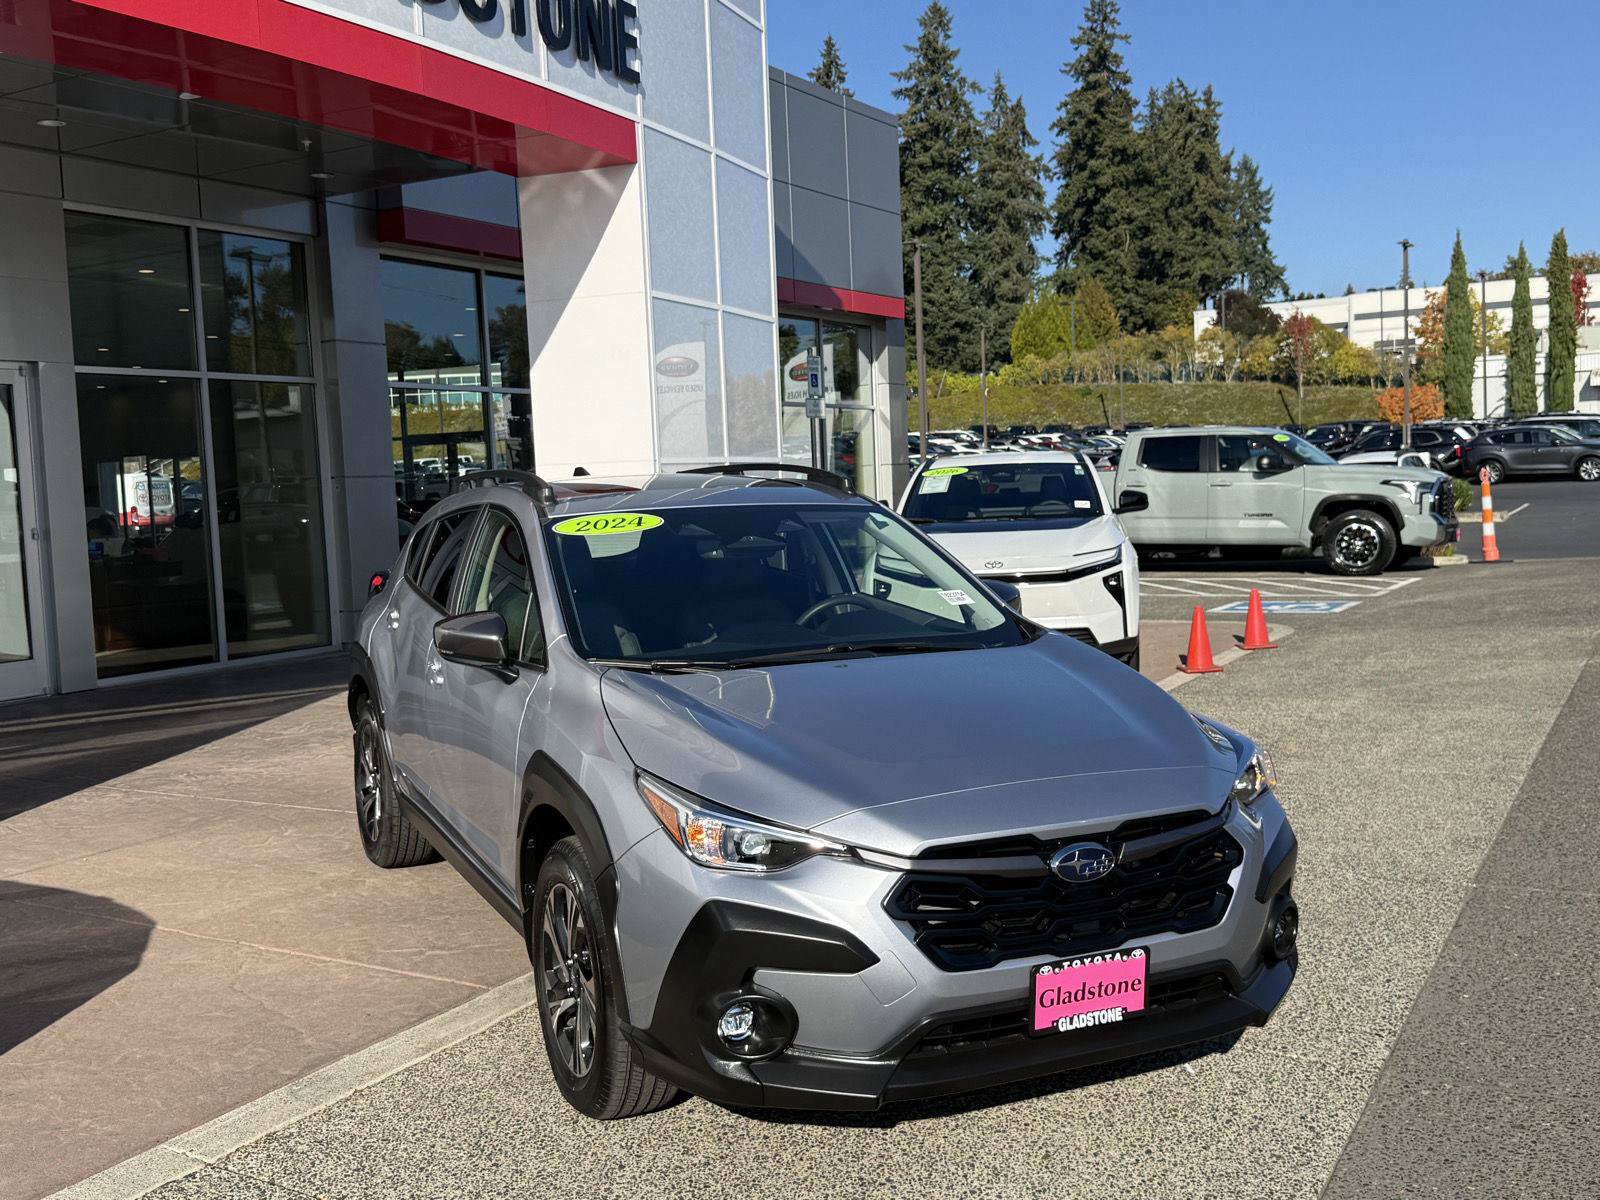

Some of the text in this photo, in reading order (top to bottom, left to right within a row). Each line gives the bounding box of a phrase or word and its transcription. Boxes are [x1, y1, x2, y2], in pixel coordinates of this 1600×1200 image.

[575, 516, 646, 532] 2024
[1062, 952, 1122, 969] TOYOTA
[1039, 977, 1142, 1008] Gladstone
[1058, 1007, 1123, 1032] GLADSTONE
